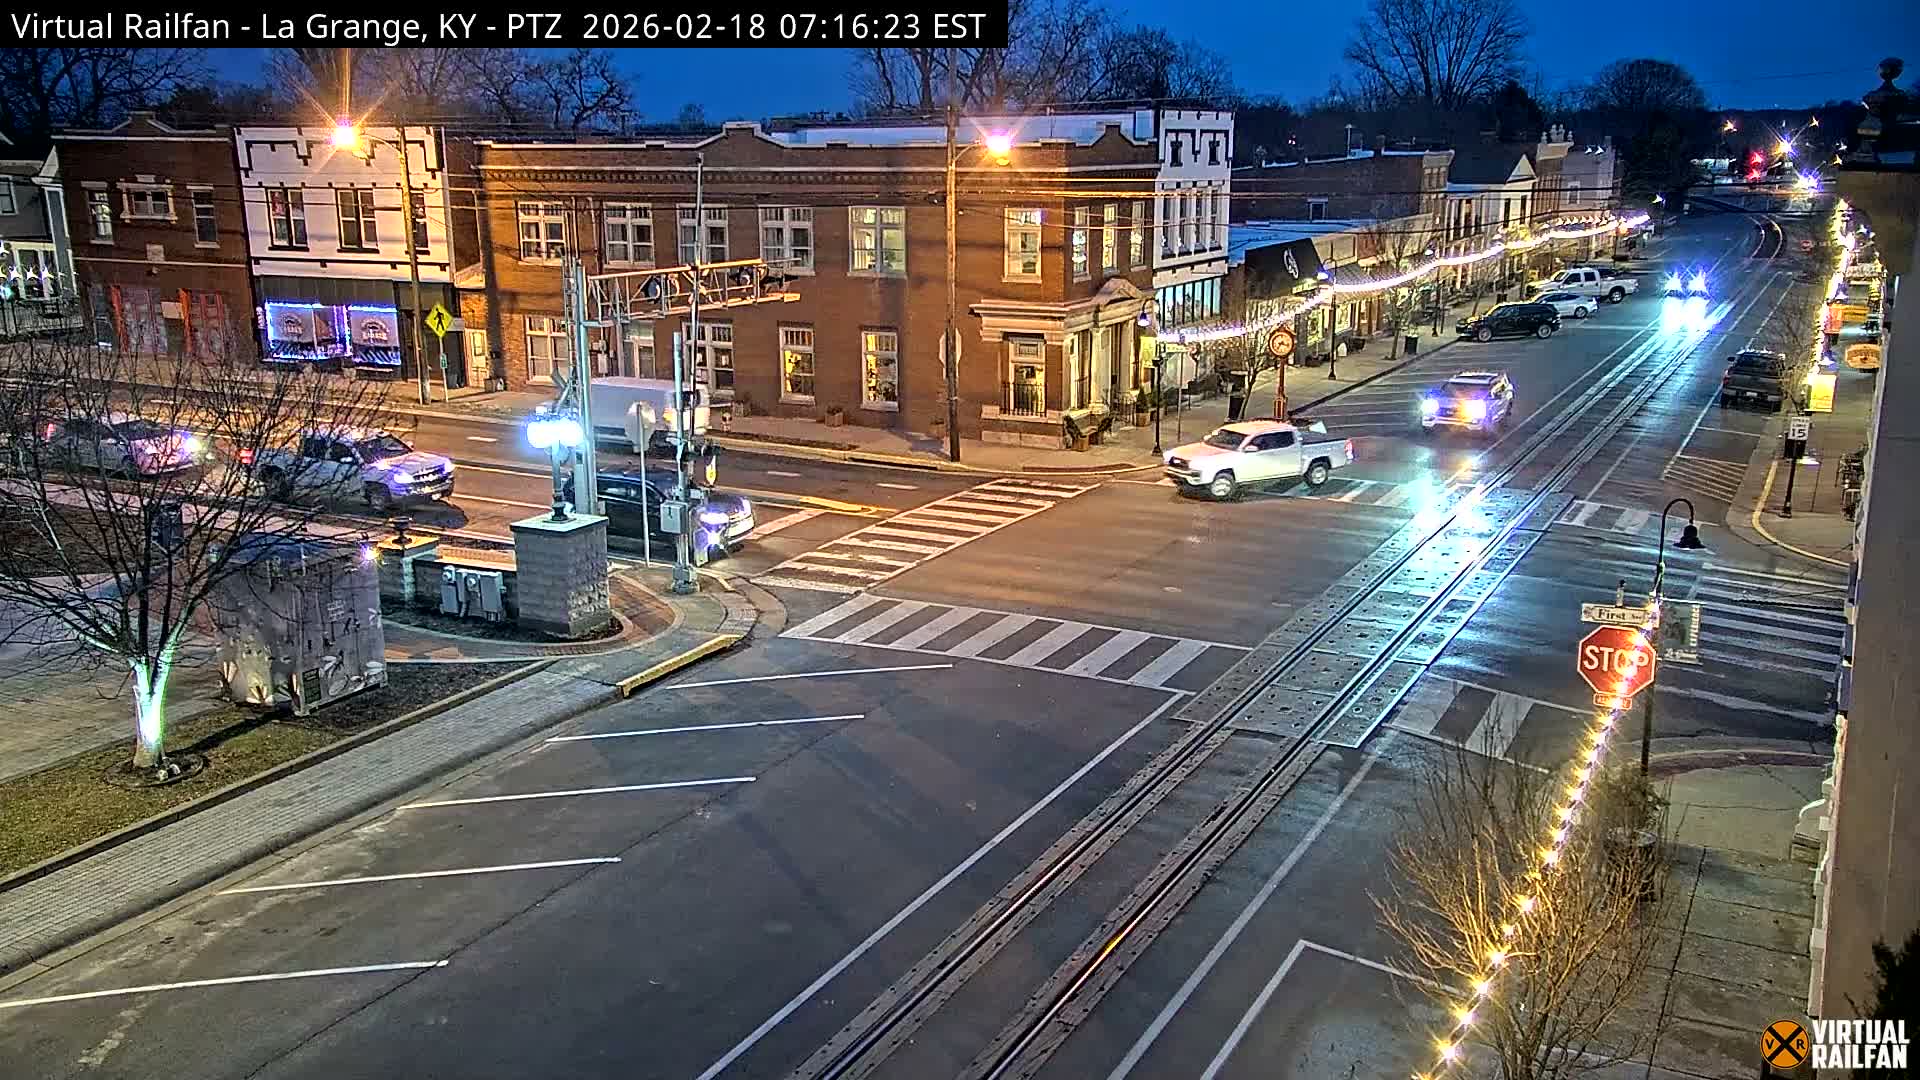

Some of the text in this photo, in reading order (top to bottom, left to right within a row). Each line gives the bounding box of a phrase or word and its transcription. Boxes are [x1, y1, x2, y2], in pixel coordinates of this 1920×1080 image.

[1792, 428, 1806, 438] 15
[1598, 608, 1626, 620] First
[1583, 645, 1649, 676] STOP
